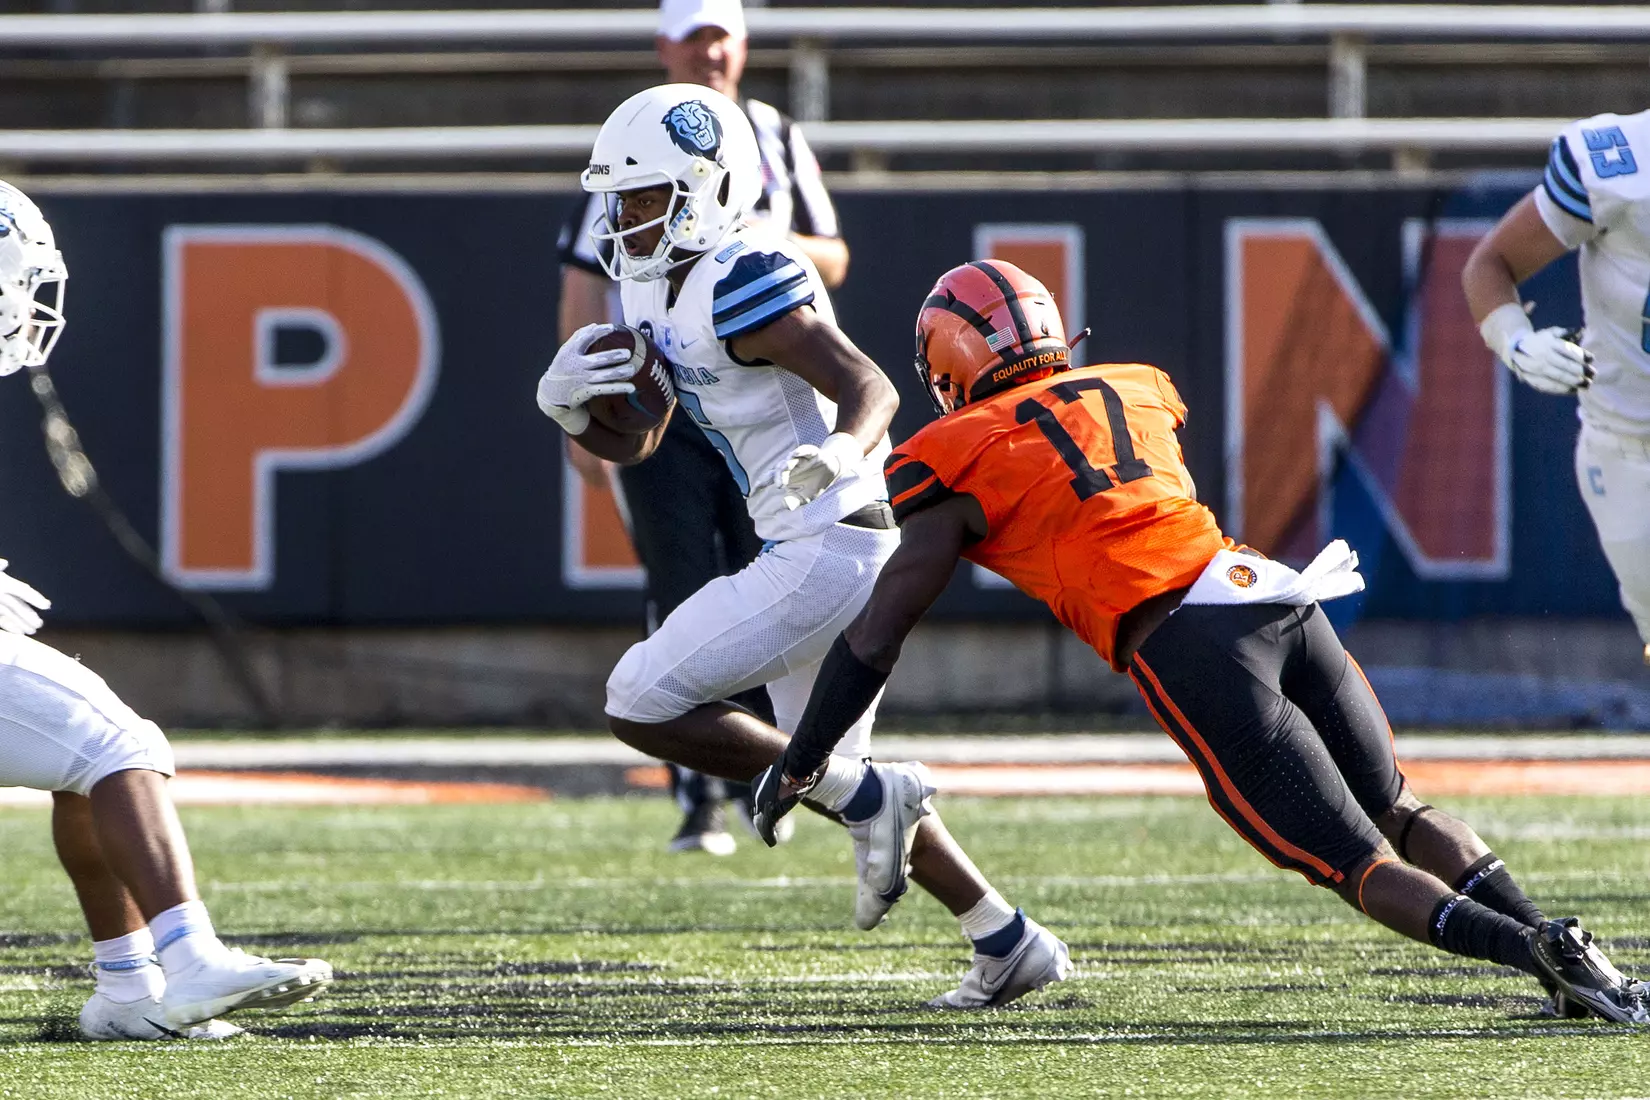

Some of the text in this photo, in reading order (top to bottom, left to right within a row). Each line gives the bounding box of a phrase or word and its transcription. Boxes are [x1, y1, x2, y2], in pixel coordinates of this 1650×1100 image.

[1581, 125, 1638, 179] 53
[992, 356, 1037, 382] EQUALITY
[1038, 352, 1055, 365] FOR
[1015, 377, 1154, 501] 17
[1460, 867, 1490, 894] NIKE
[1436, 899, 1457, 929] NIKE
